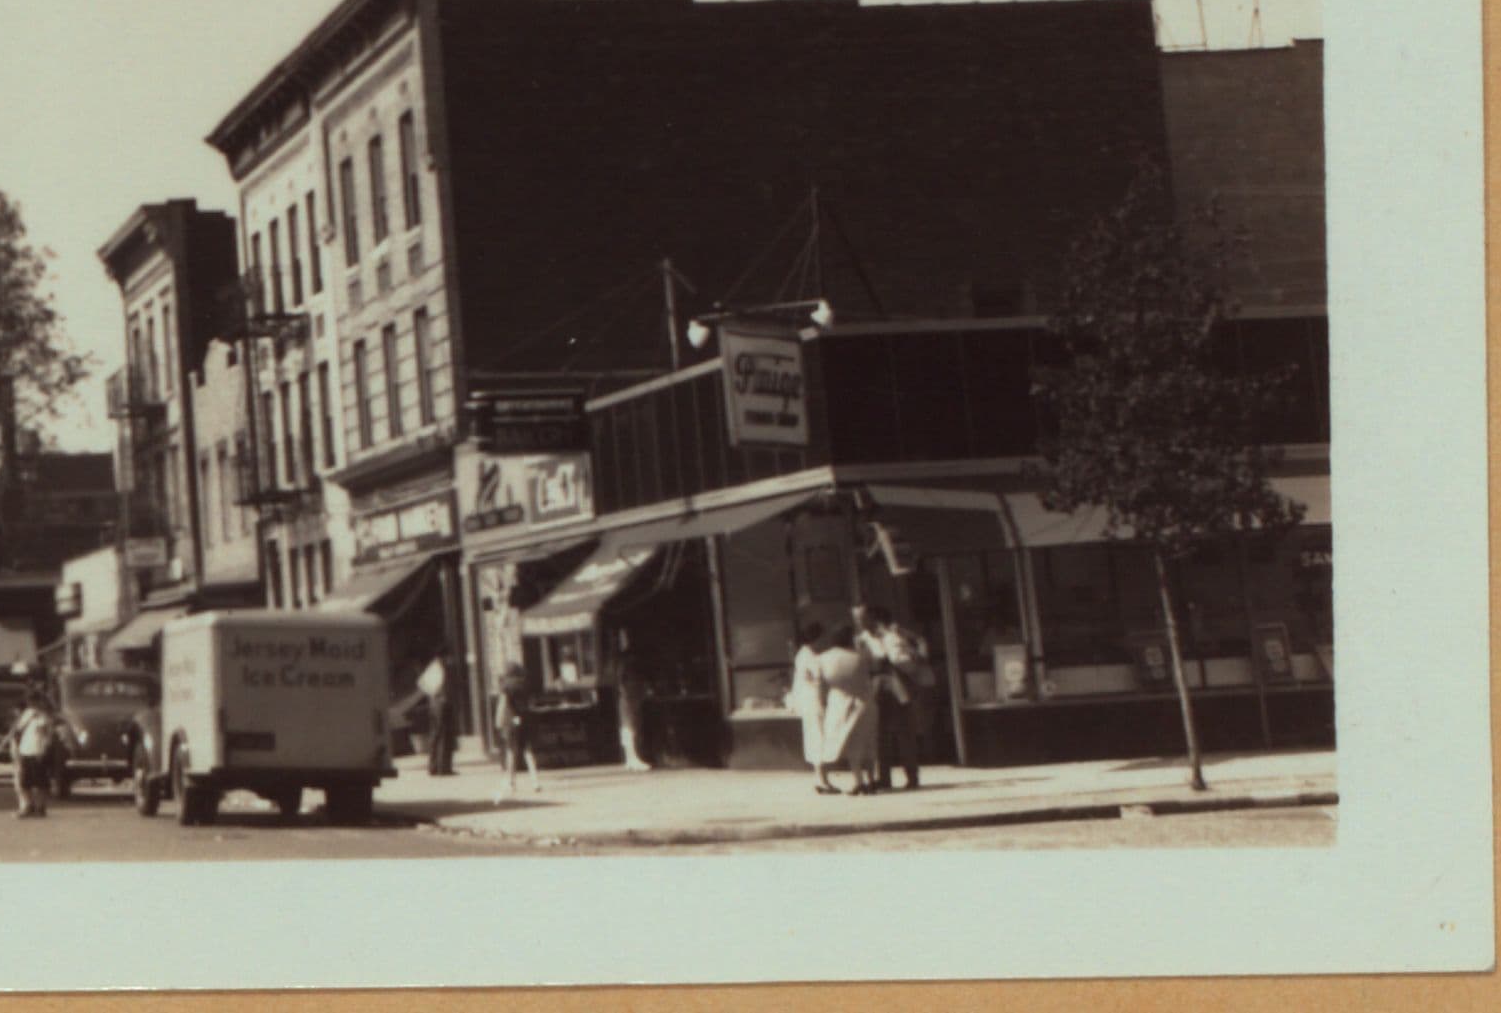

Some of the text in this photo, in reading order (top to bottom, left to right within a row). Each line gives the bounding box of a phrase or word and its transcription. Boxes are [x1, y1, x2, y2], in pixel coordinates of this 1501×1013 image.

[230, 634, 366, 663] Jersey Maid
[241, 664, 355, 688] Ice Cream
